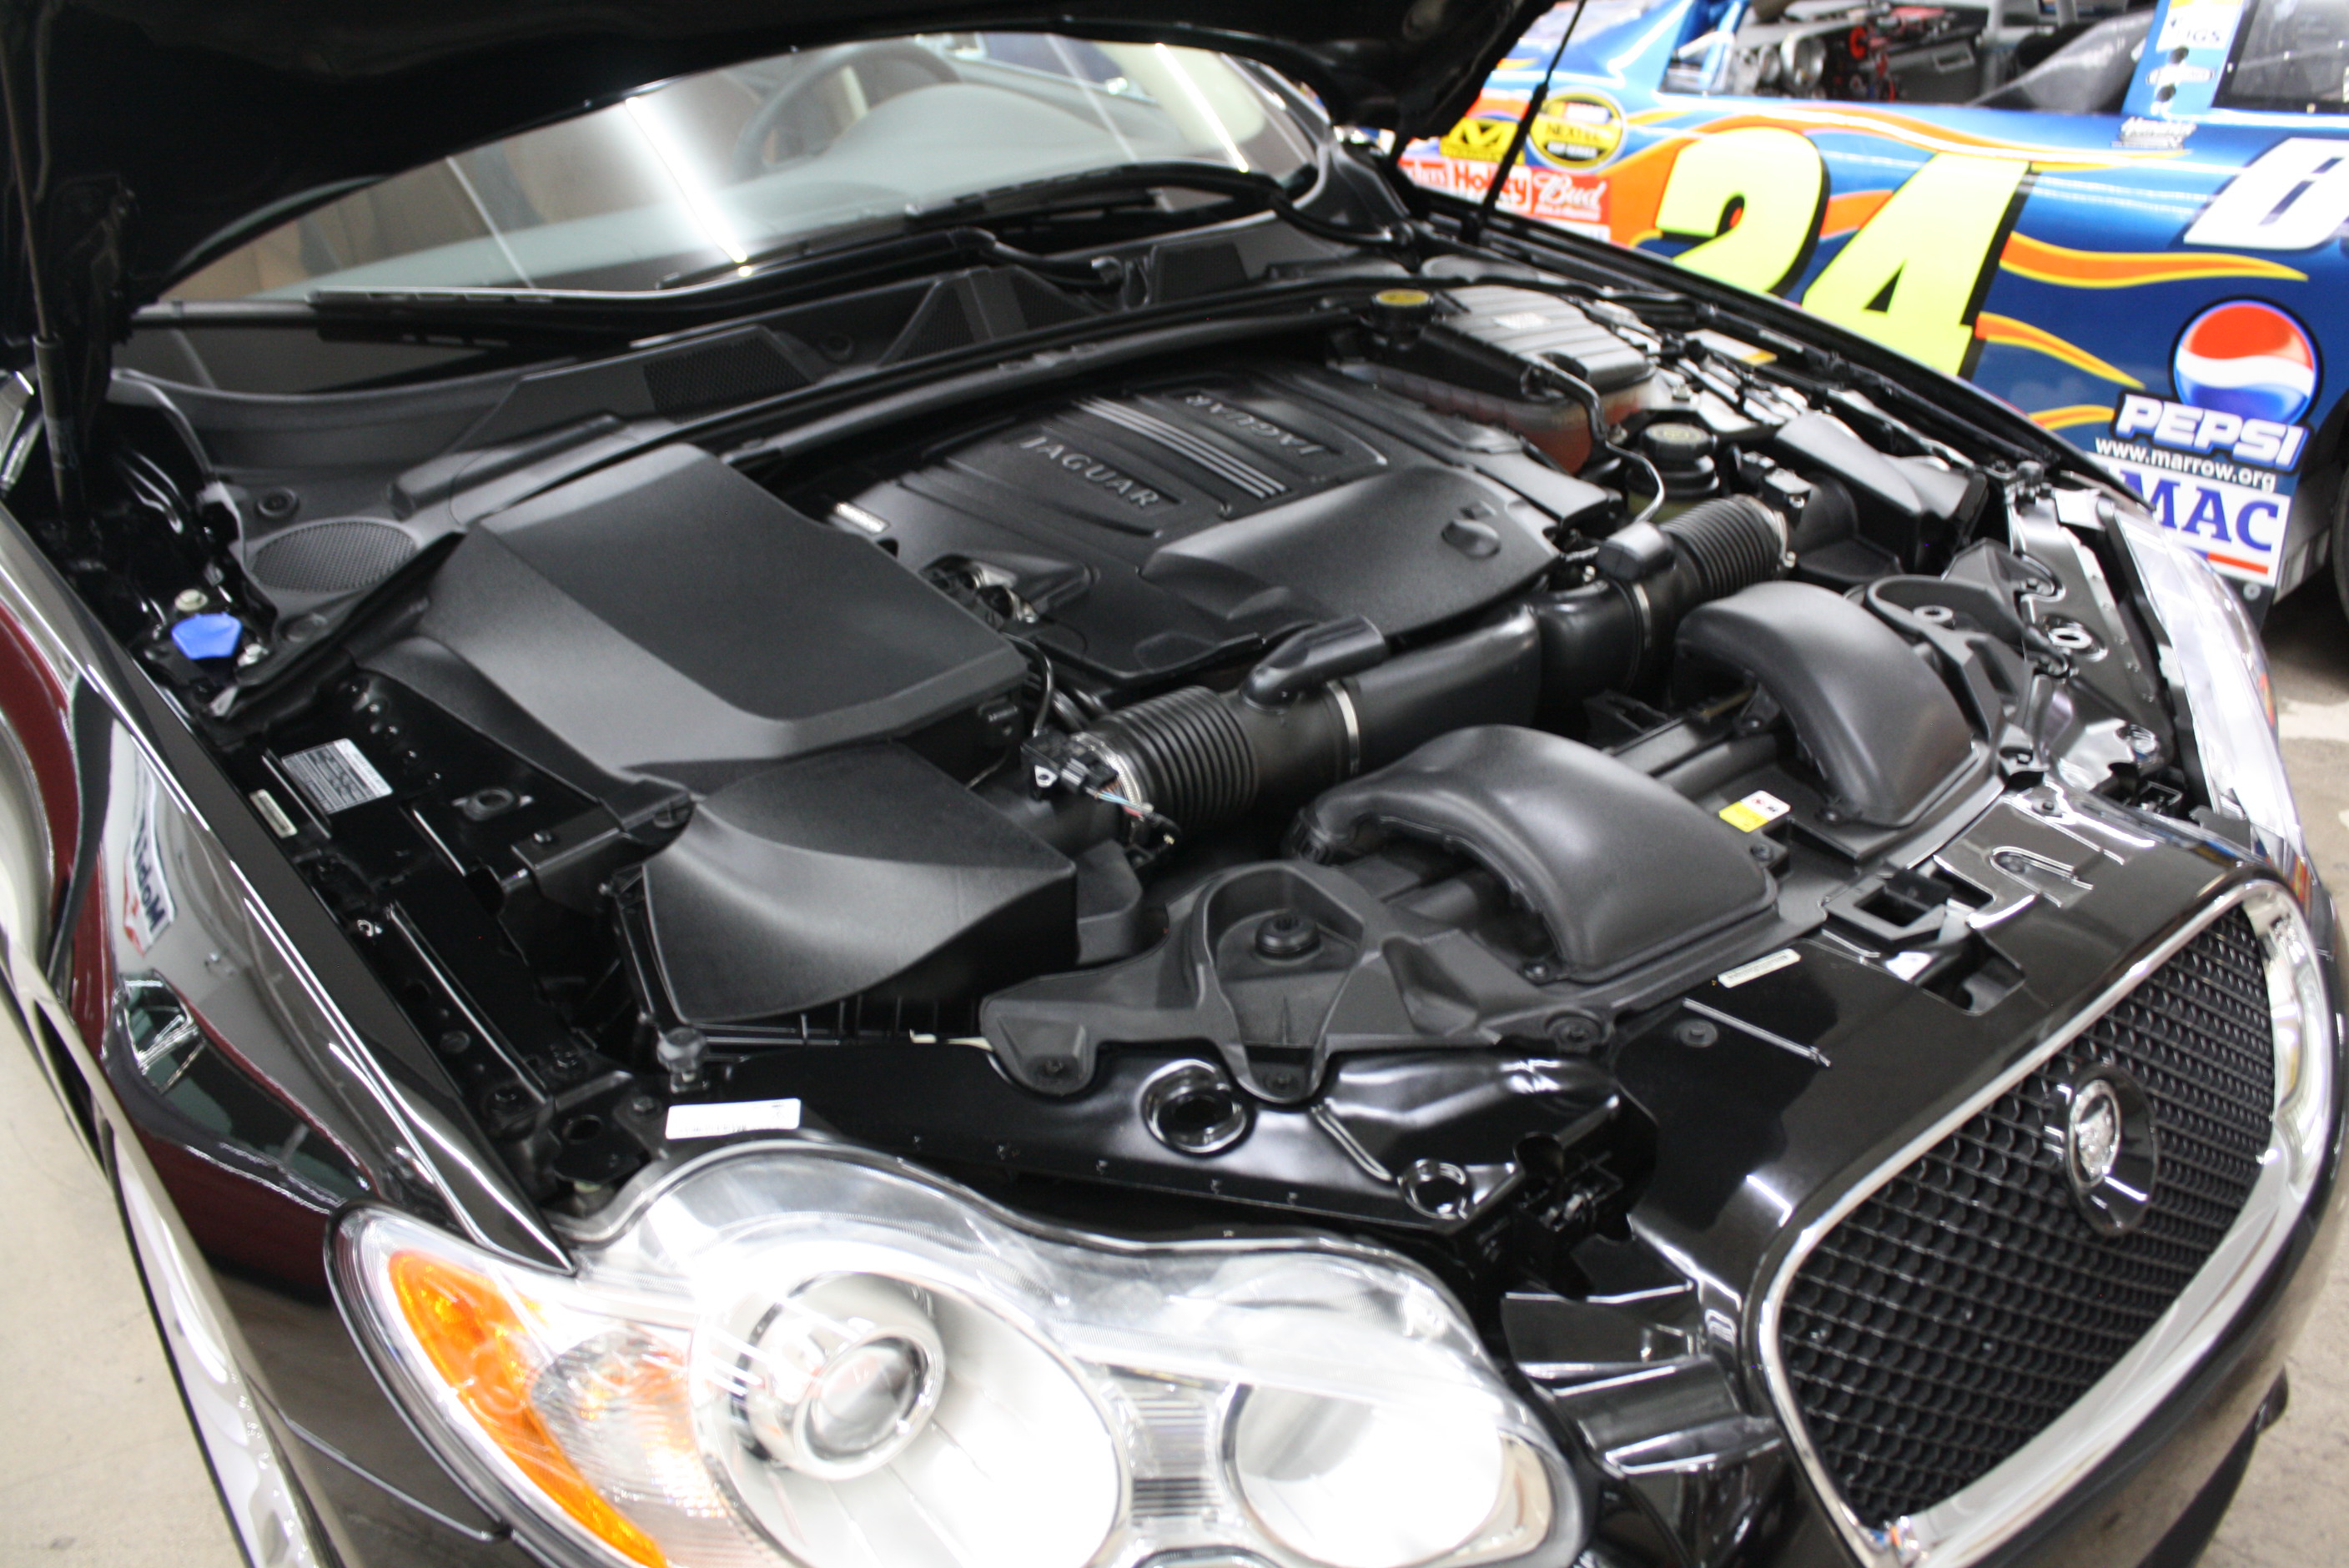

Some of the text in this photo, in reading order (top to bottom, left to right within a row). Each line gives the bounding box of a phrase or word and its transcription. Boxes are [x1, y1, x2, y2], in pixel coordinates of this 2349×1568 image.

[2095, 437, 2277, 493] www.marrow.org
[2115, 393, 2308, 471] PEPSI
[1019, 435, 1160, 508] JAGUAR
[2101, 465, 2280, 553] MAC
